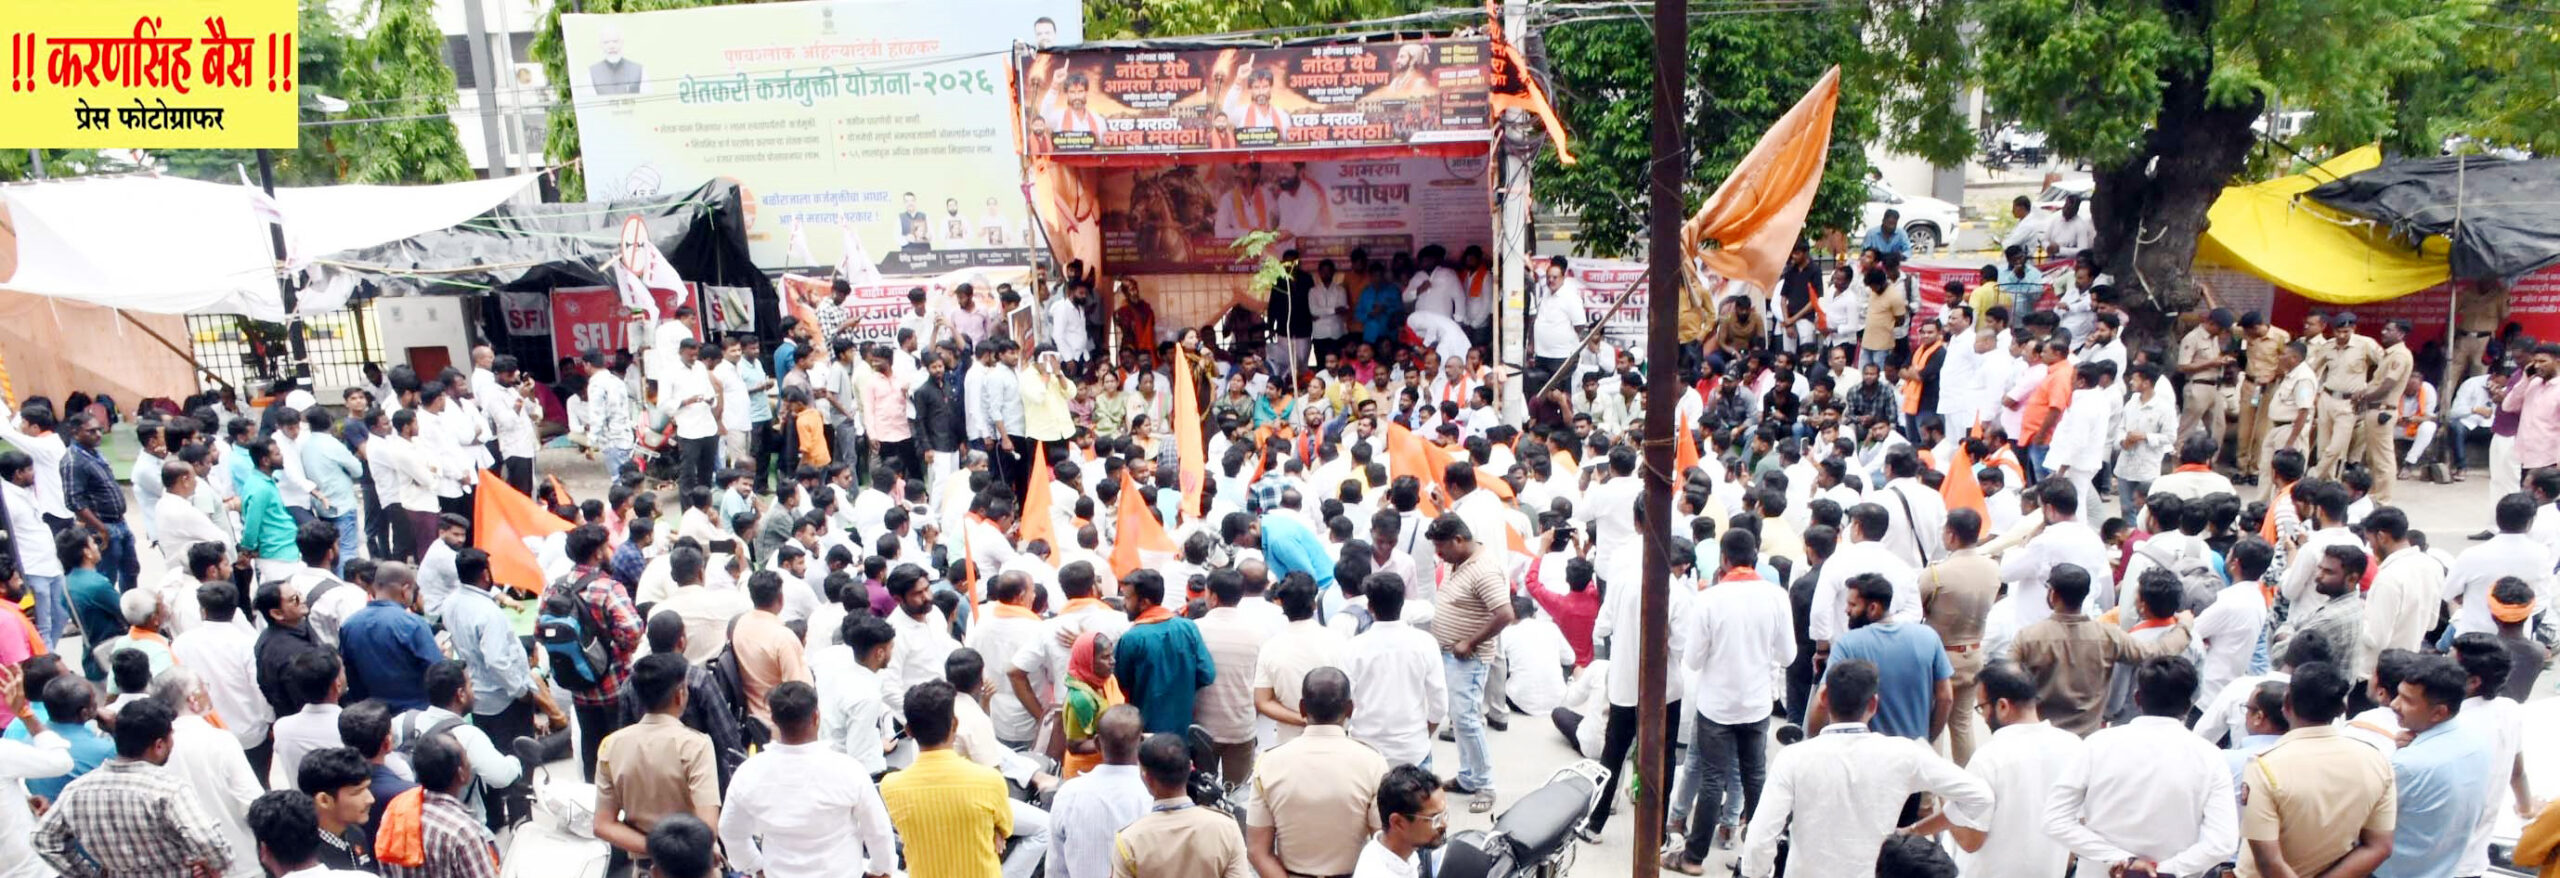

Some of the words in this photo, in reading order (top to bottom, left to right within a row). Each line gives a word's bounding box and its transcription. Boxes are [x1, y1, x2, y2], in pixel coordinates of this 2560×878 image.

[888, 37, 940, 58] होळकर
[1115, 61, 1159, 80] नांदेड
[1163, 59, 1190, 79] येथे
[1301, 55, 1347, 74] नांदेड
[679, 74, 750, 104] शेतकरी
[755, 66, 839, 107] कर्जमुक्ती
[842, 66, 994, 97] योजना-२०२६
[1104, 78, 1152, 94] आमरण
[1155, 76, 1202, 92] उपोषण
[1289, 72, 1338, 88] आमरण
[1342, 70, 1391, 86] उपोषण
[1107, 118, 1135, 131] एक
[1292, 114, 1319, 127] एक
[1103, 130, 1144, 146] लाख
[1147, 128, 1207, 145] मराठा!
[1287, 125, 1328, 141] लाख
[1338, 161, 1401, 178] आमरण
[1331, 178, 1411, 205] उपोषण
[509, 310, 546, 330] SFI
[572, 322, 612, 352] SFI
